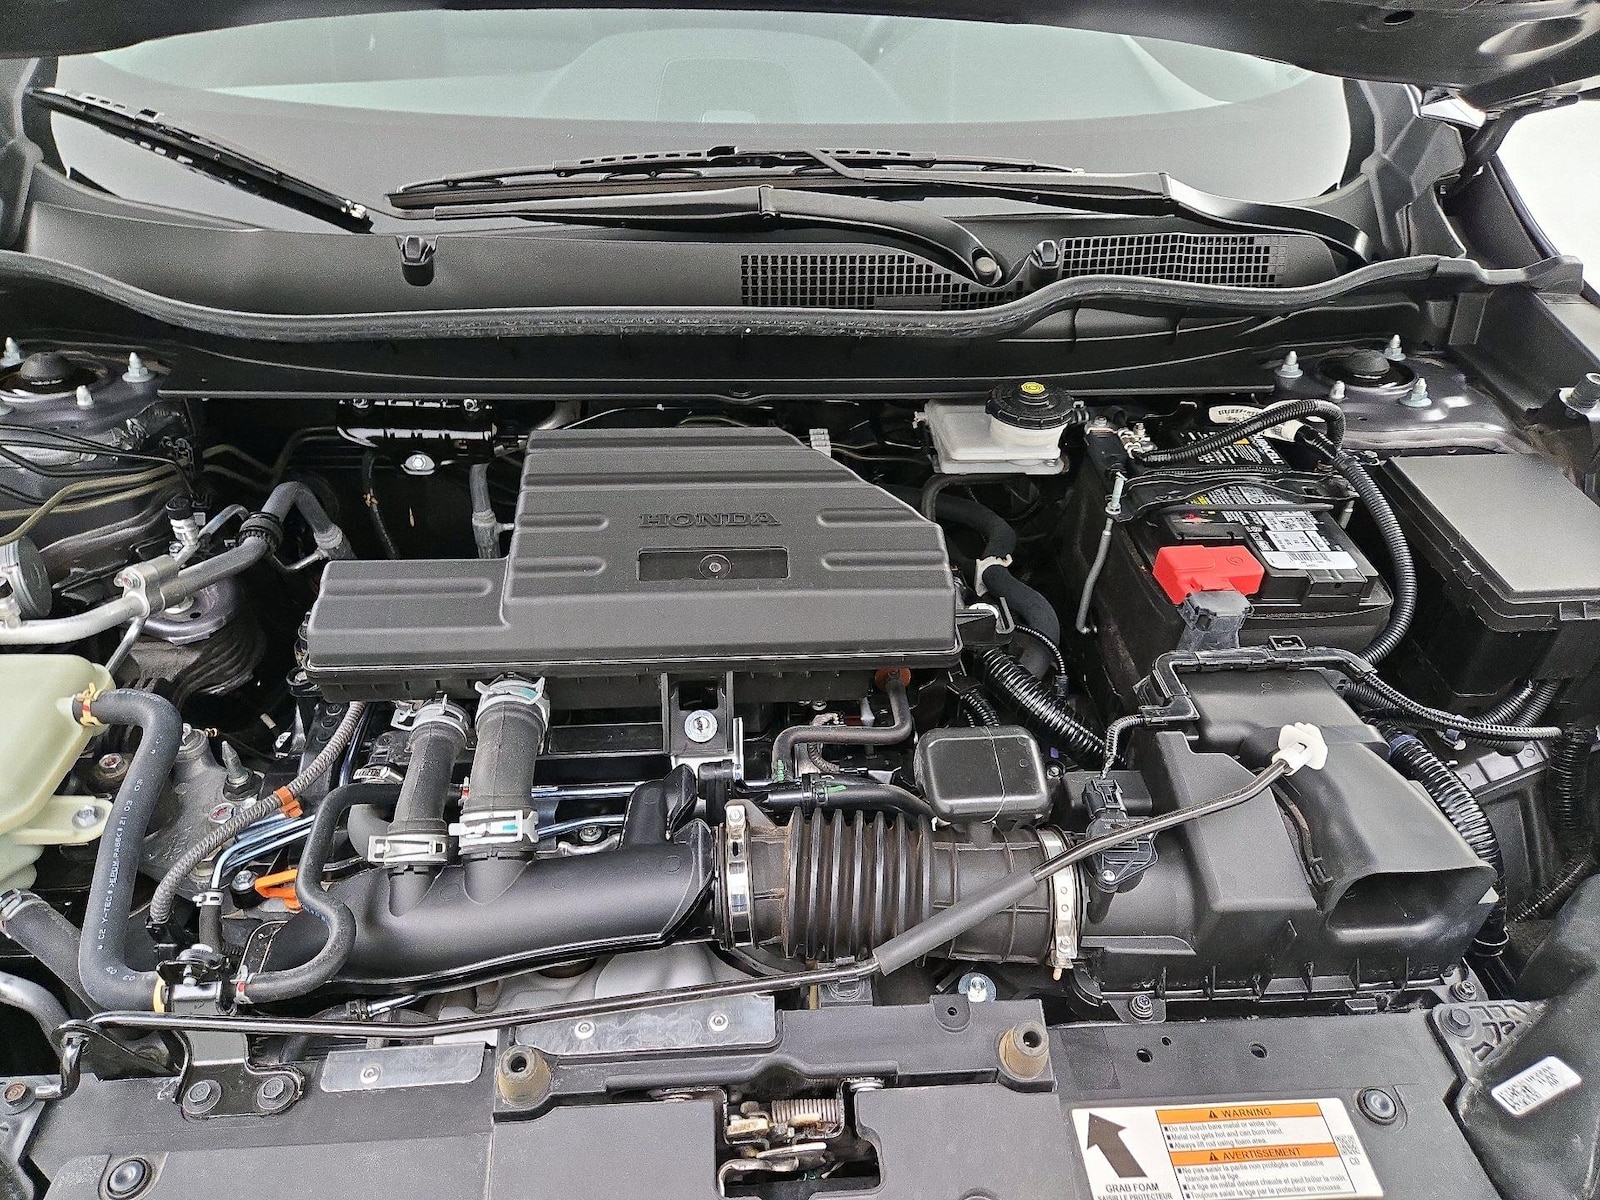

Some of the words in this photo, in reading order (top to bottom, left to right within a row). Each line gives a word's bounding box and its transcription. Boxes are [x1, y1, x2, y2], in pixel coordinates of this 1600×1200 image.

[638, 512, 782, 528] HONDA
[1221, 1107, 1272, 1118] WARNING
[1223, 1147, 1300, 1160] AVERTISSEMENT
[1105, 1184, 1132, 1193] GRAB
[1132, 1182, 1160, 1192] FOAM
